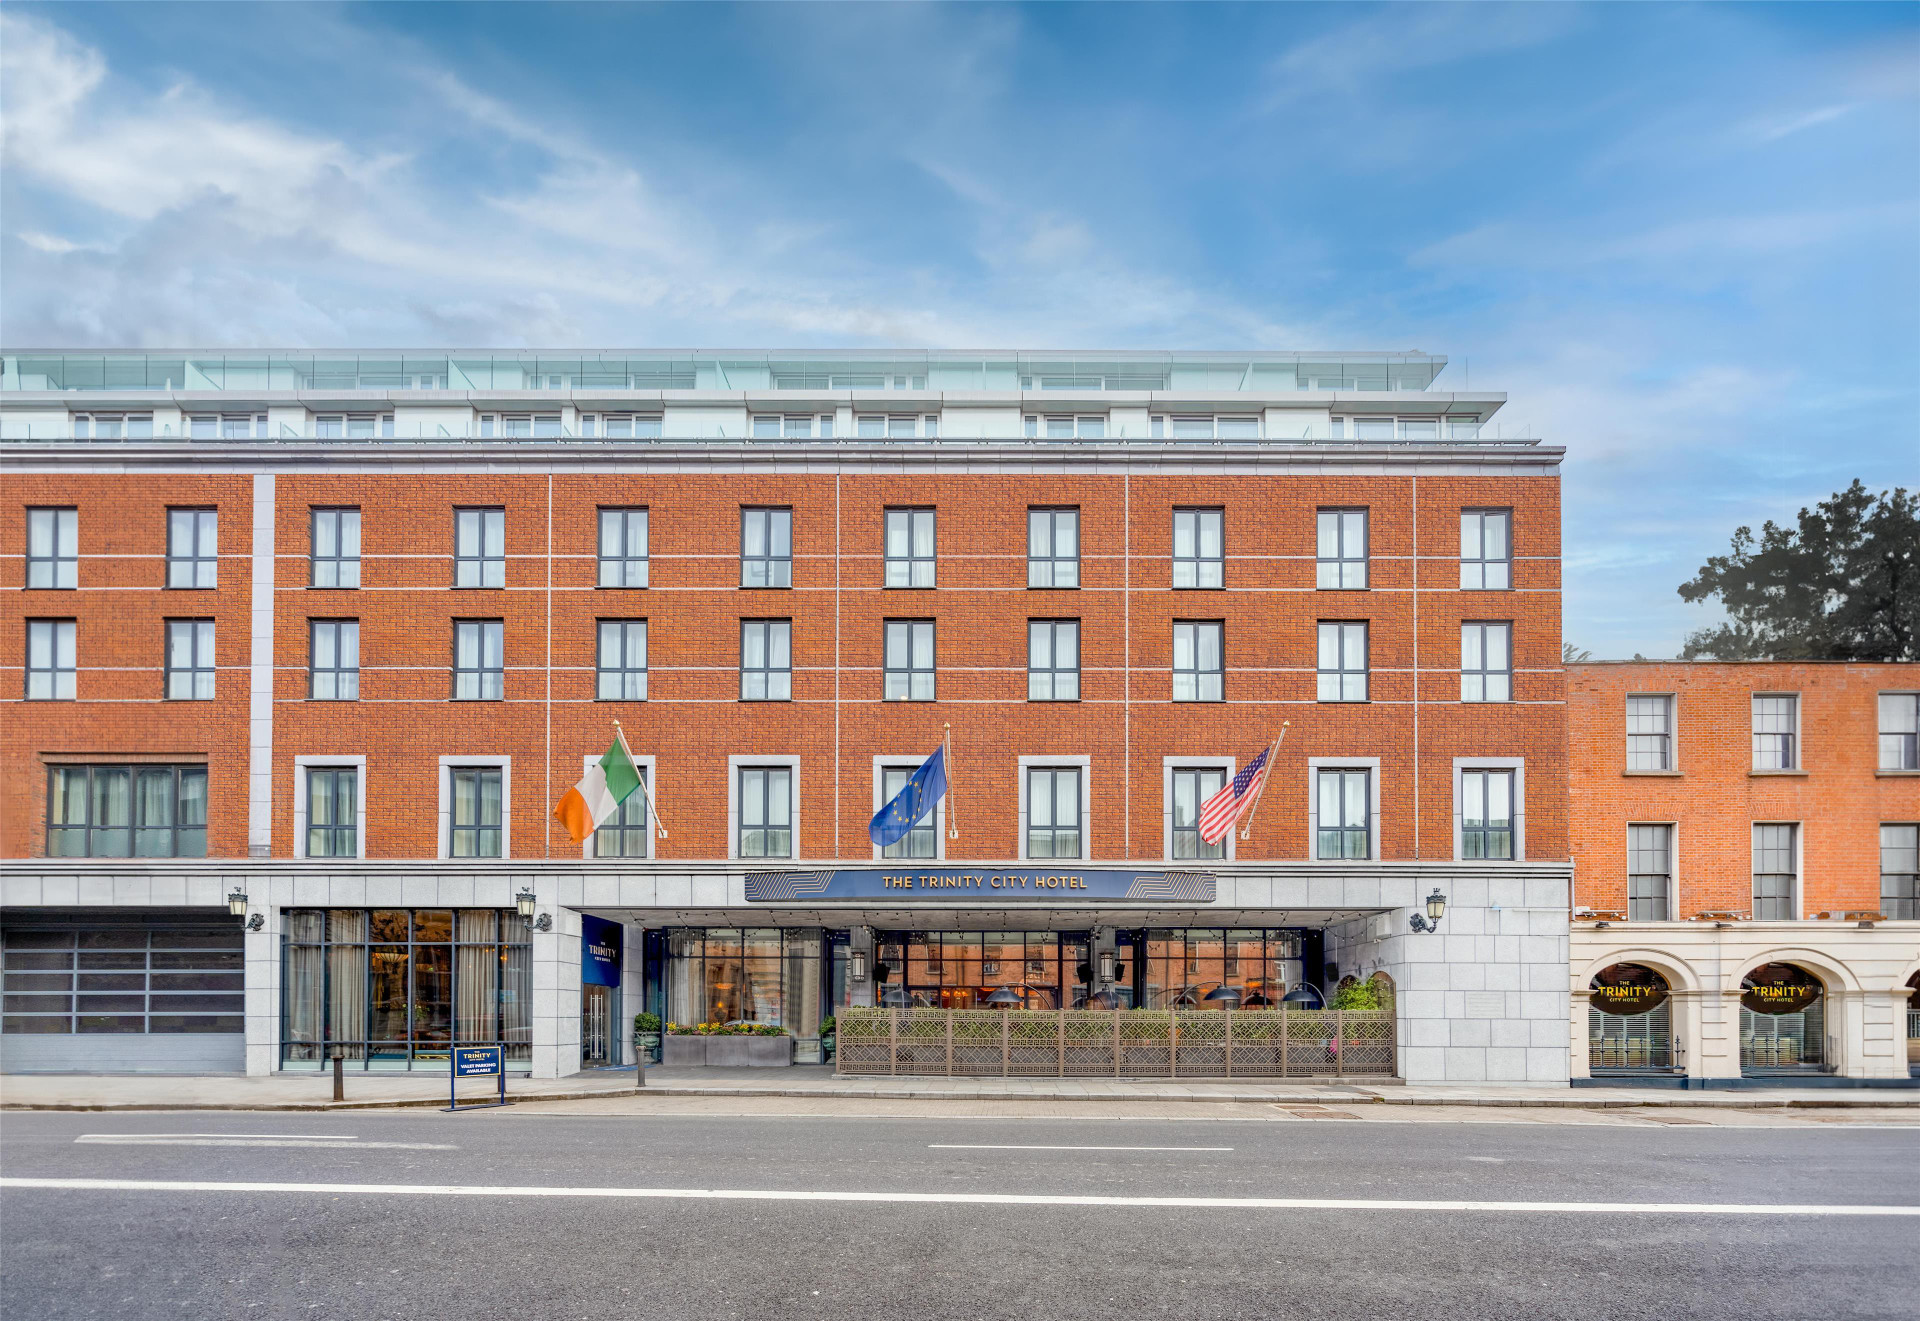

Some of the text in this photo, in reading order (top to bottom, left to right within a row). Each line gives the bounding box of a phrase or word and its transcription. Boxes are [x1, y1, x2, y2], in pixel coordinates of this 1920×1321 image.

[883, 876, 1088, 888] THE TRINITY CITY HOTEL
[588, 944, 616, 958] TRINITY
[1598, 986, 1651, 996] TRINITY
[1752, 986, 1805, 996] TRINITY
